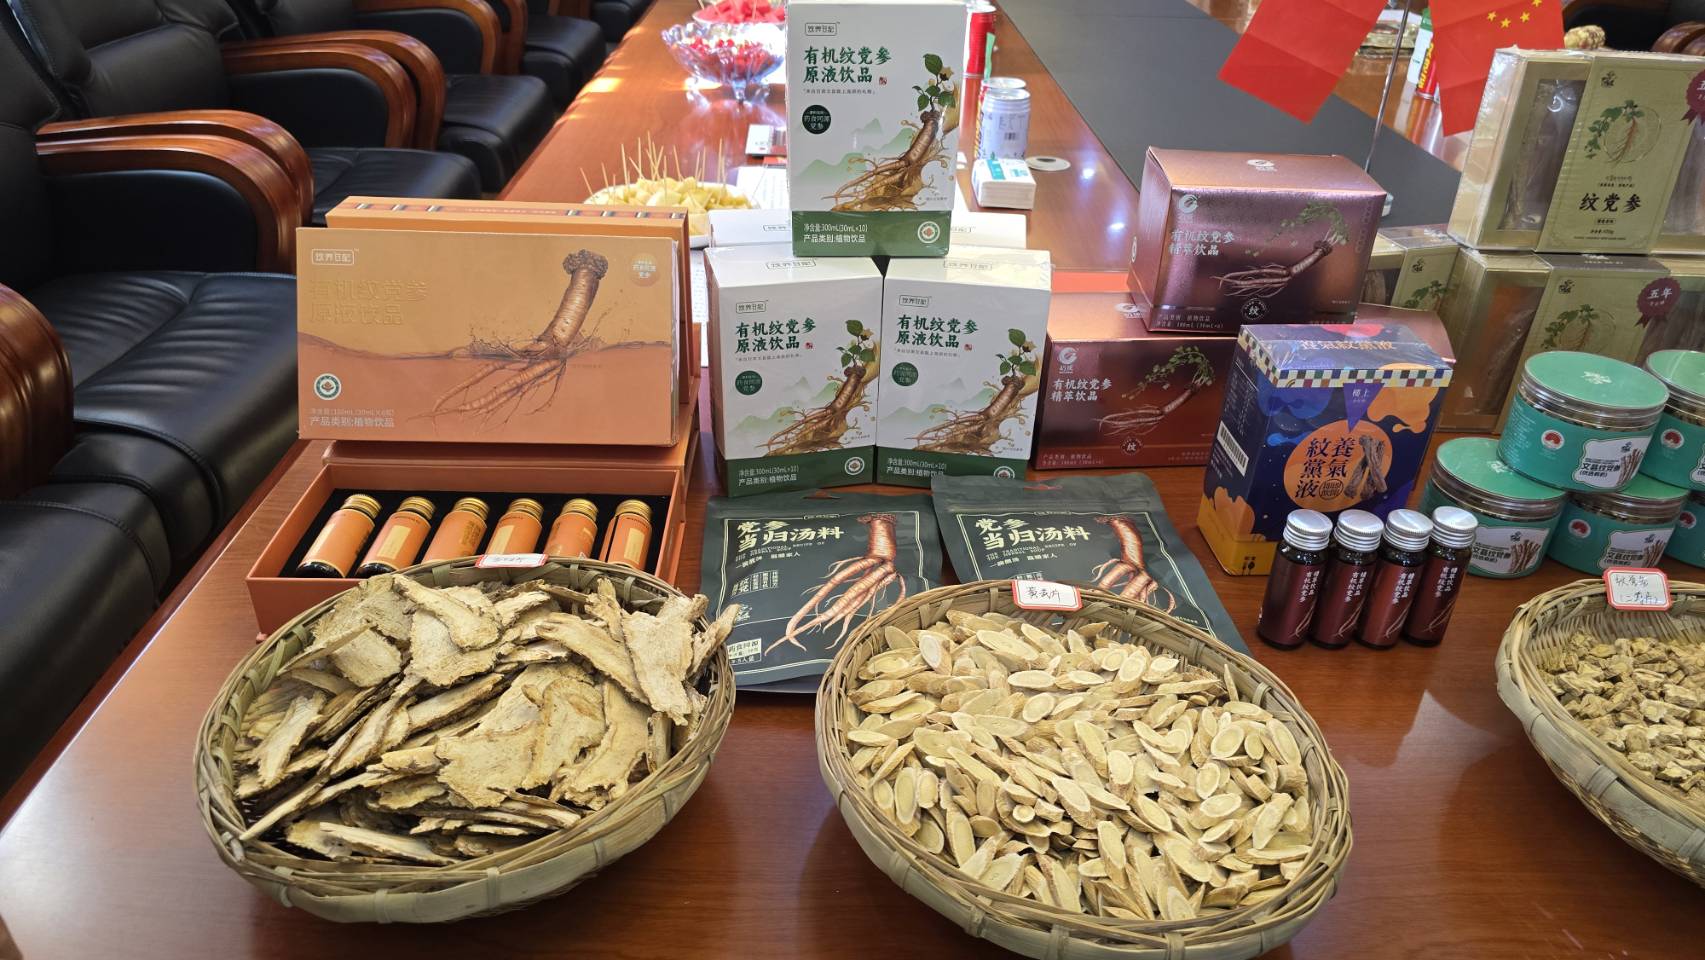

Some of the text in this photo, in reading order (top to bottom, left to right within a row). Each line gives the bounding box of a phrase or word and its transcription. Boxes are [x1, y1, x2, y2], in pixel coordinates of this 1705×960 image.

[803, 45, 892, 66] 有机纹党参
[802, 65, 873, 84] 原液饮品
[1579, 193, 1642, 213] 纹党参
[1171, 230, 1234, 243] 有机纹党参
[1648, 287, 1673, 299] 五年
[735, 317, 816, 339] 有机纹党参
[897, 314, 979, 335] 有机纹党参
[735, 335, 800, 353] 原液饮品
[895, 330, 960, 348] 原液饮品
[1053, 378, 1113, 391] 有机纹党参
[737, 520, 790, 540] 党参
[974, 518, 1029, 536] 党参
[738, 526, 844, 553] 当归汤料
[983, 526, 1091, 550] 当归汤料
